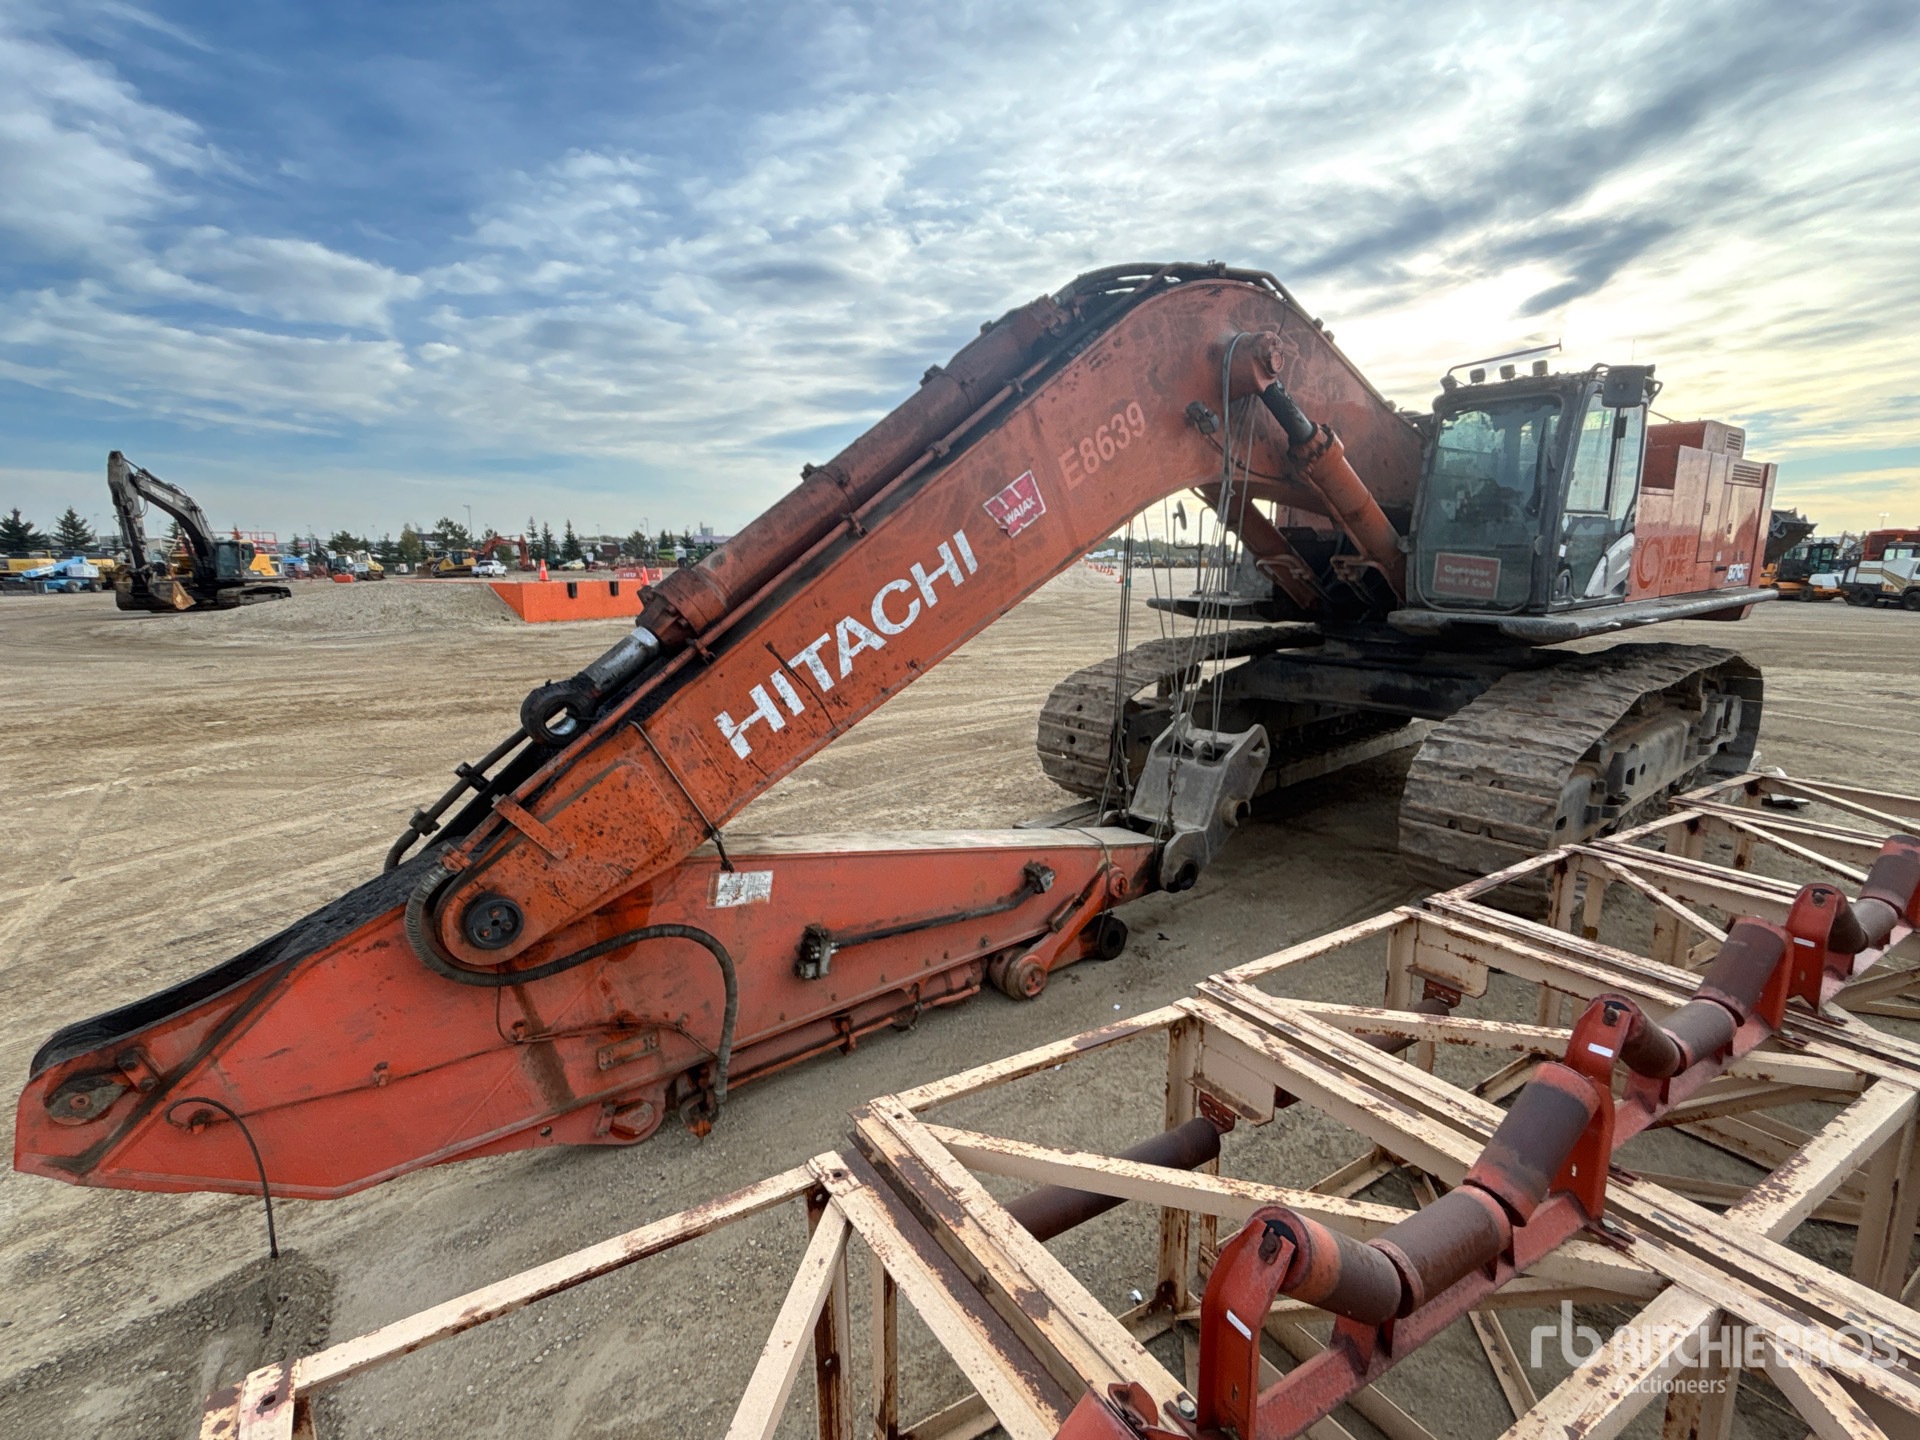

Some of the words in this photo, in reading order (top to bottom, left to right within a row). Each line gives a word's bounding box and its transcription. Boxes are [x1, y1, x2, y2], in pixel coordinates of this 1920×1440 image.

[1057, 400, 1147, 493] E8639
[1003, 496, 1036, 524] WAJAX
[1444, 564, 1491, 576] Operator
[713, 528, 979, 760] HITACHI
